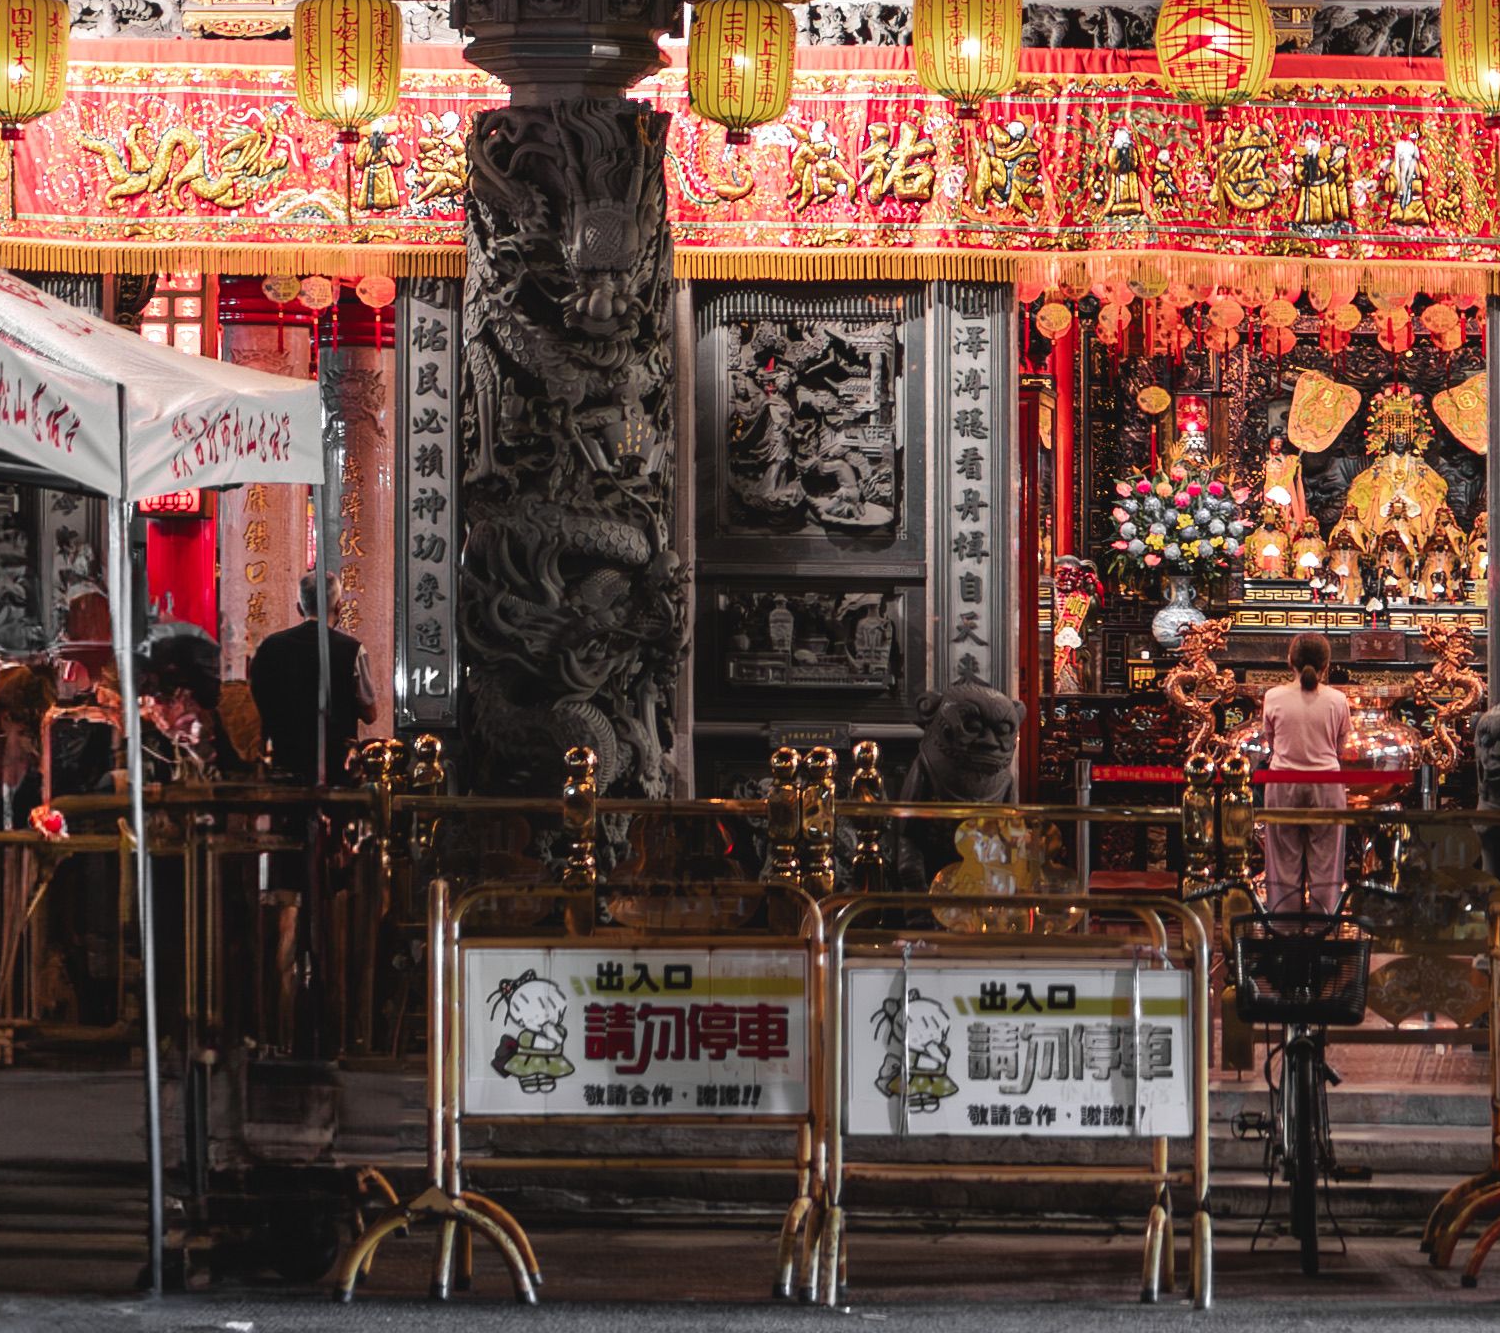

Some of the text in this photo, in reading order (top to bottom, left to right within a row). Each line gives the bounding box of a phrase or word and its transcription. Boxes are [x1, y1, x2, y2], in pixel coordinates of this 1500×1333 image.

[756, 15, 779, 103] 天上聖母
[596, 962, 693, 993] 出入口
[979, 981, 1076, 1012] 出入口
[584, 1003, 790, 1075] 請勿停車
[967, 1021, 1174, 1094] 請勿停車
